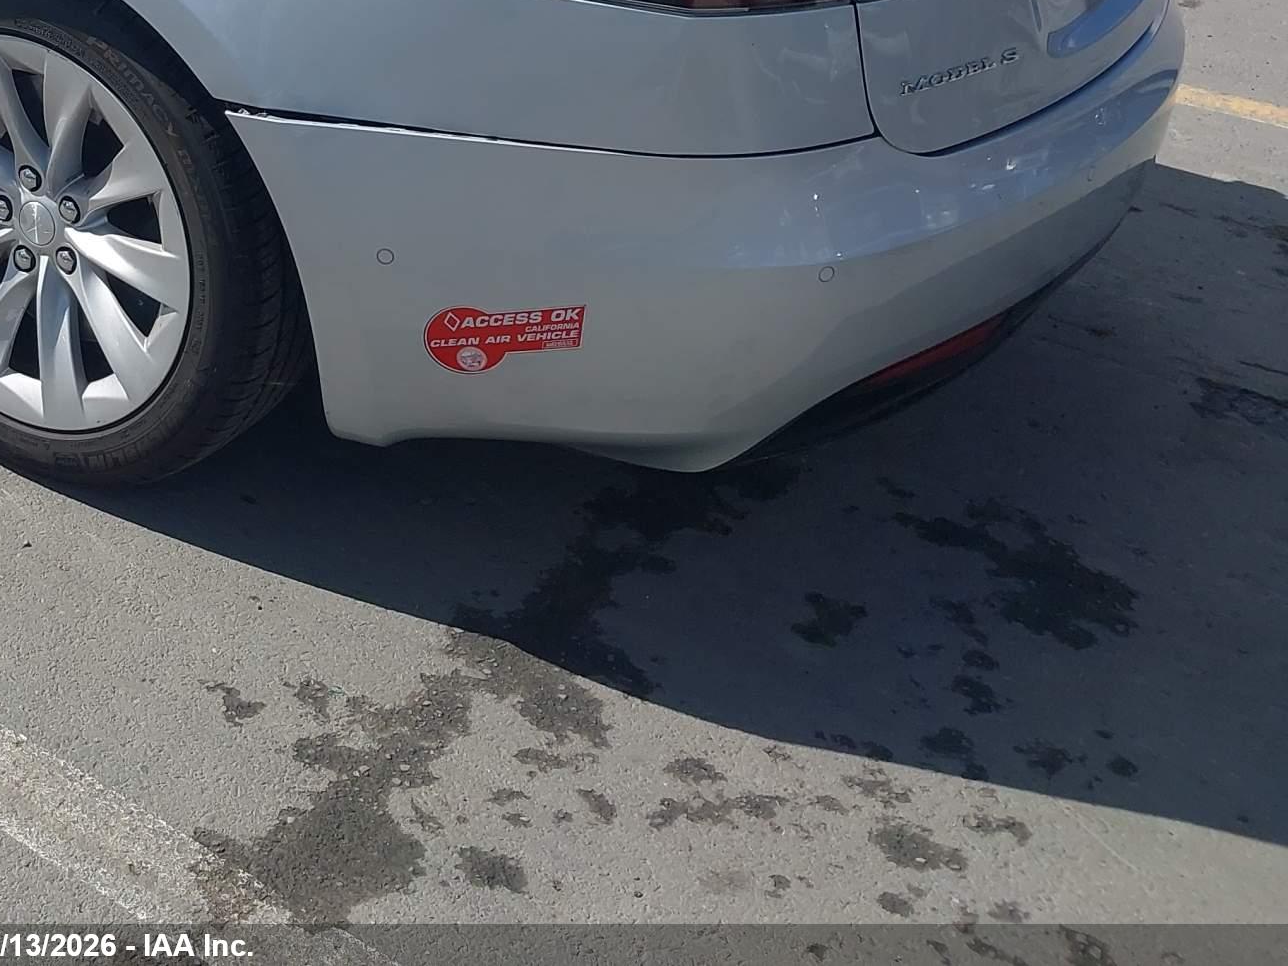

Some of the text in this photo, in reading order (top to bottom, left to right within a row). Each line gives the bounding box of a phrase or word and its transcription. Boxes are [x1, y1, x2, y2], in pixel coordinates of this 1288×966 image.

[900, 46, 1020, 96] MODEL S
[461, 308, 581, 329] ACCESS OK
[525, 322, 580, 333] CALIFORNIA
[430, 329, 580, 348] CLEAN AIR VEHICLE
